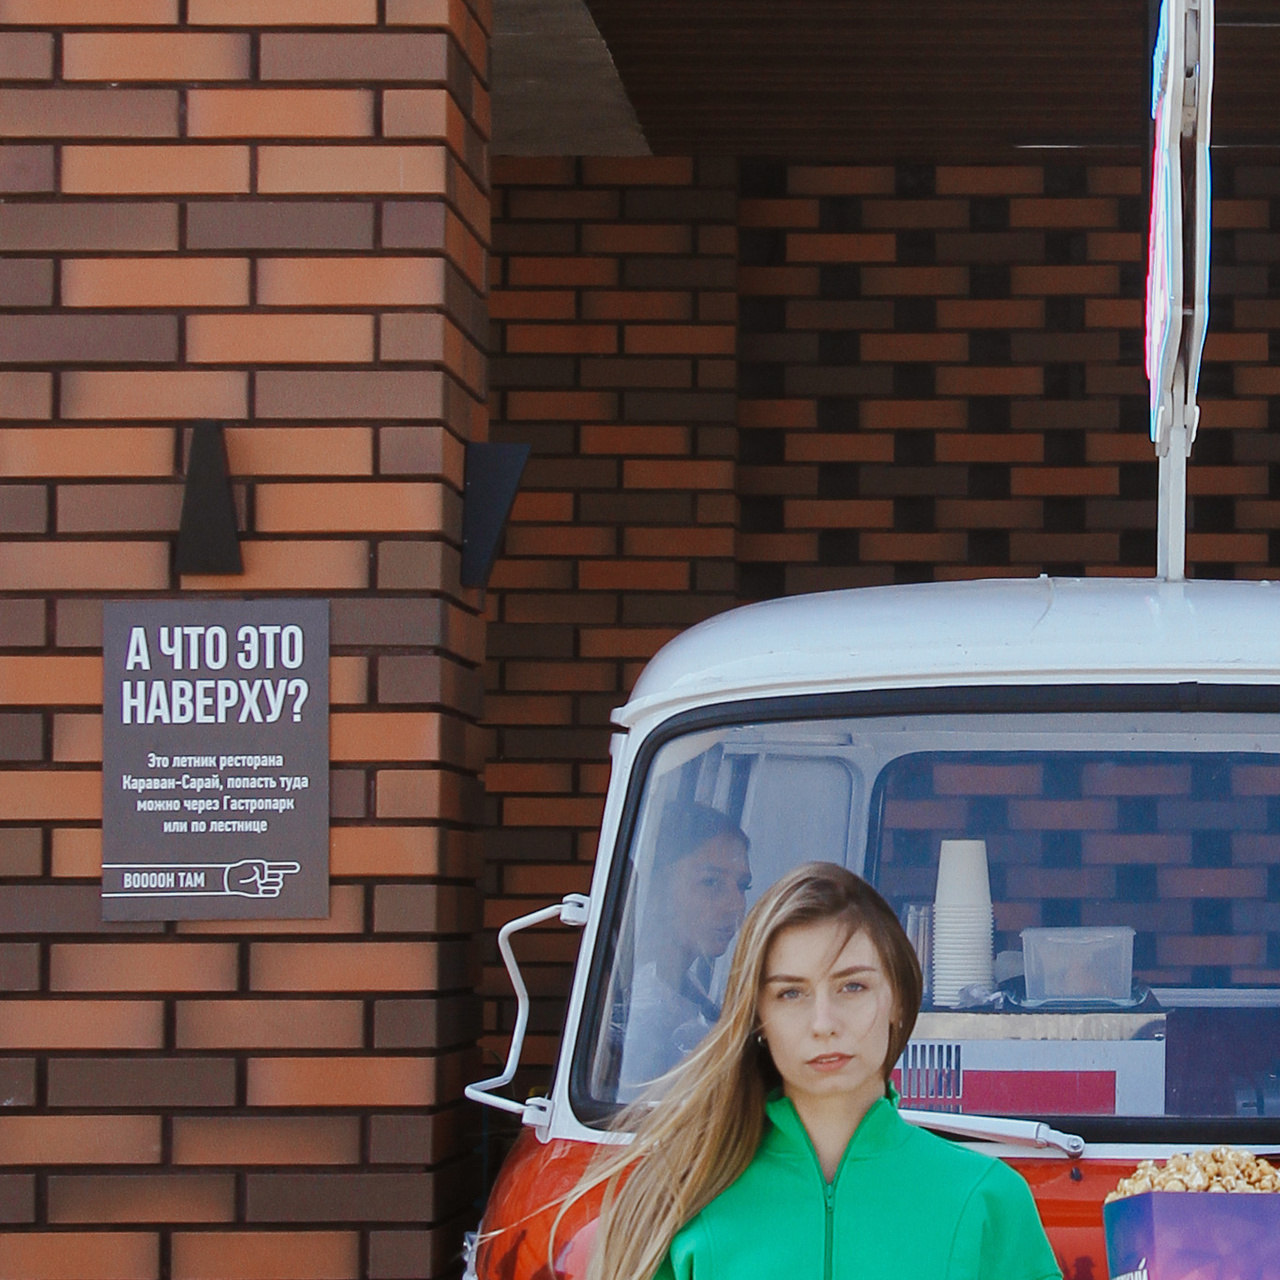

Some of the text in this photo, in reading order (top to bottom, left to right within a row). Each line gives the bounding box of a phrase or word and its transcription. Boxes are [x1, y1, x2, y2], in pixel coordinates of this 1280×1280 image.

[125, 624, 304, 671] А ЧТО ЭТО
[122, 678, 309, 724] НАВЕРХУ?
[147, 752, 284, 771] Это летник ресторана
[122, 773, 309, 792] Караван-Сарай, попасть туда
[136, 795, 295, 815] можно через Гастропарк
[163, 819, 268, 835] или по лестнице
[123, 871, 205, 889] ВООООН ТАМ
